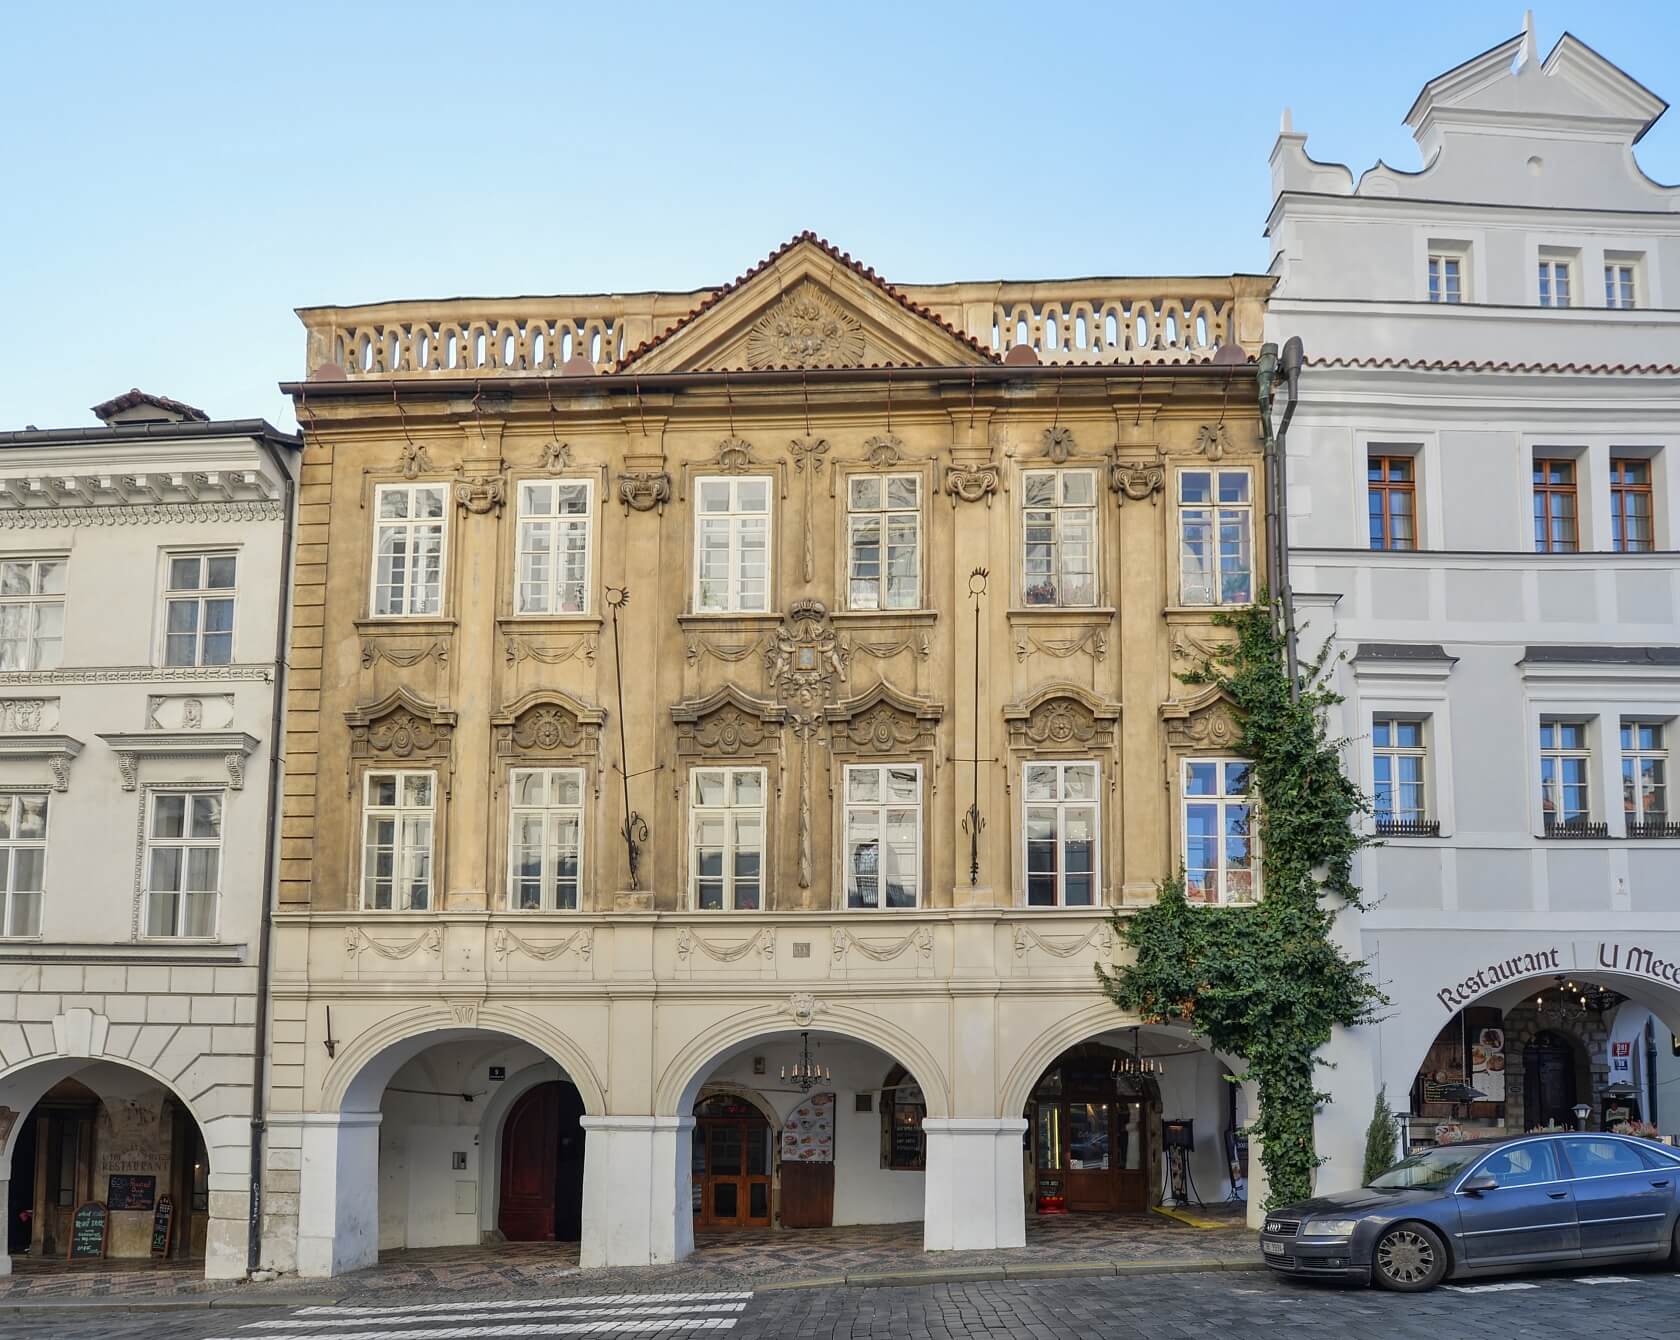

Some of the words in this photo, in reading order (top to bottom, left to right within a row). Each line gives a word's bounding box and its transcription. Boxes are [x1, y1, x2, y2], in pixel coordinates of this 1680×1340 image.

[1437, 946, 1560, 1014] Restaurant
[1599, 943, 1619, 969] U
[1625, 946, 1680, 985] Mece
[102, 1160, 169, 1172] RESTAURANT
